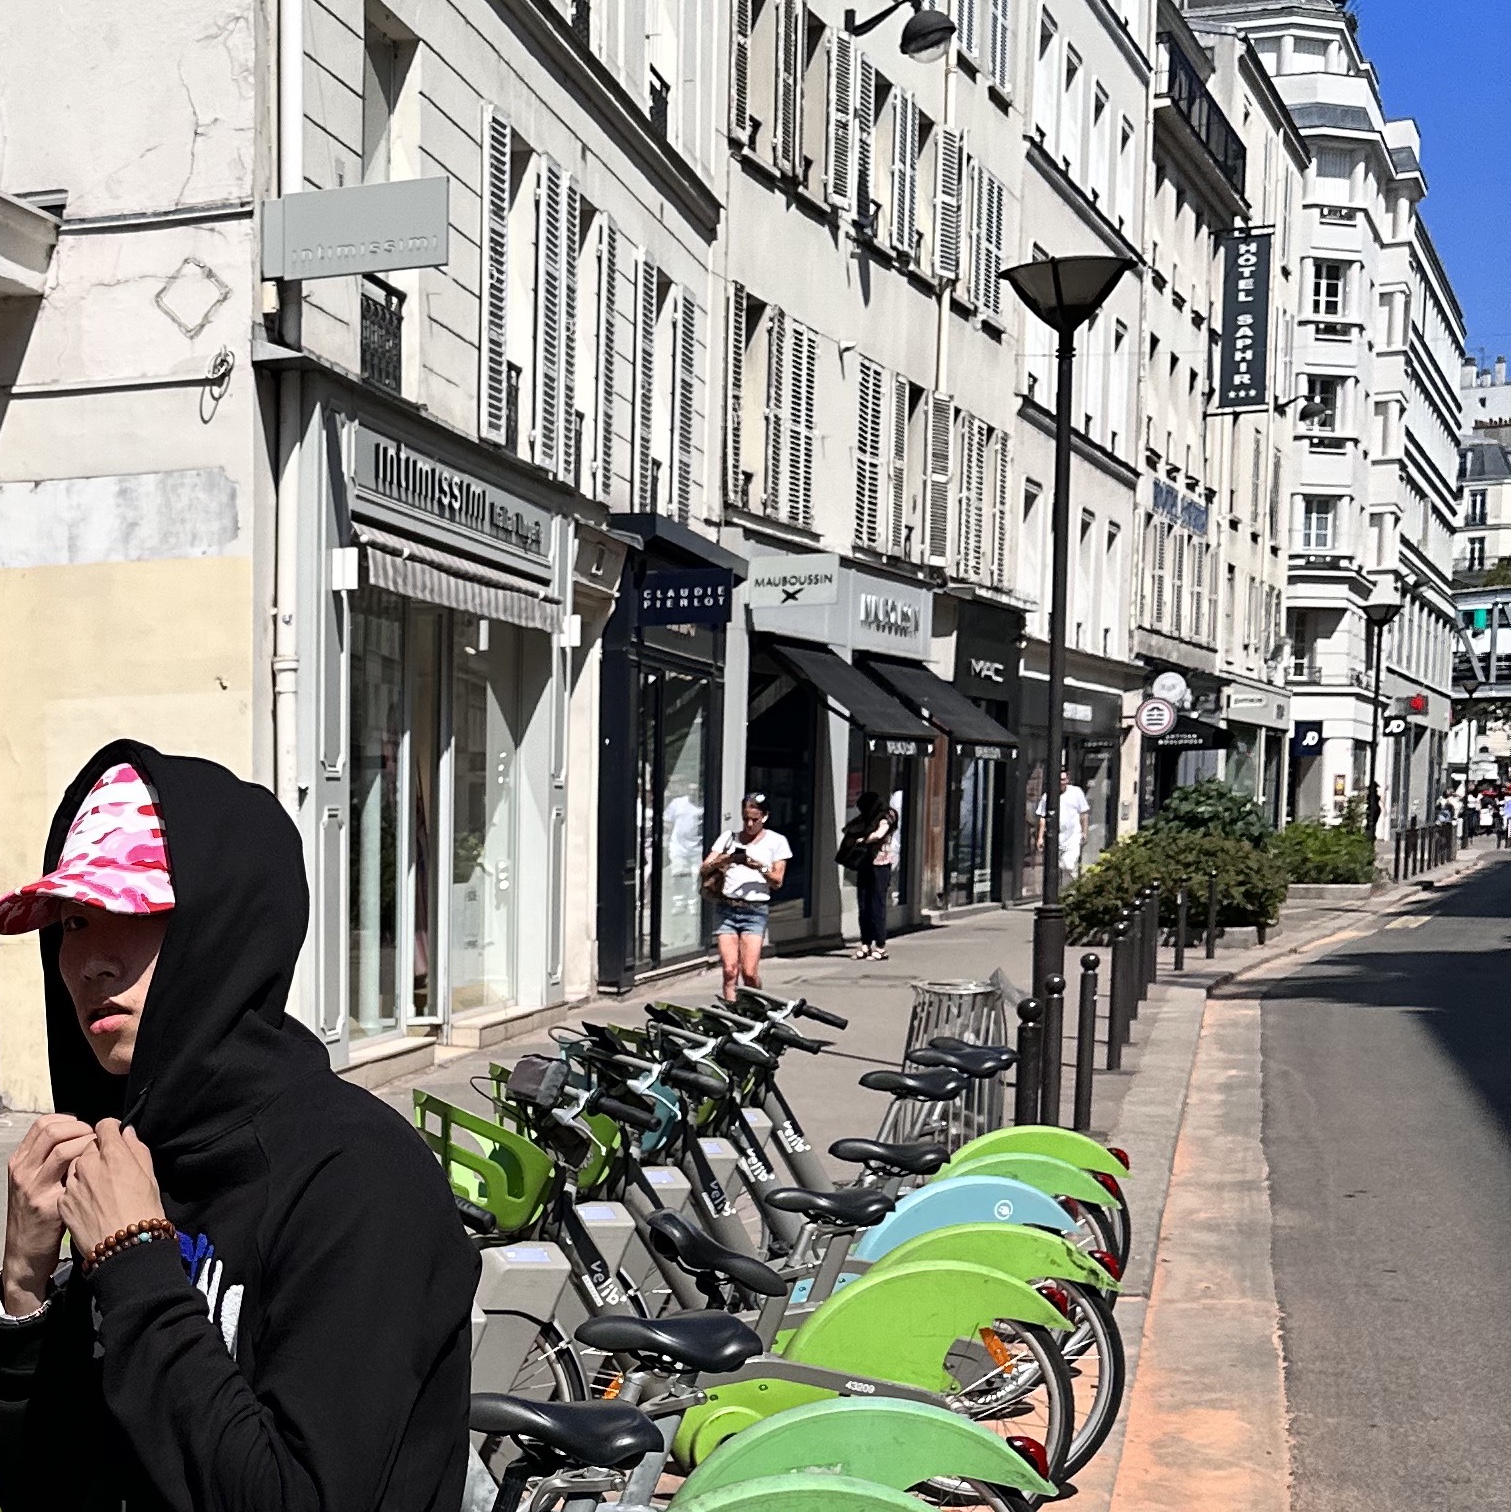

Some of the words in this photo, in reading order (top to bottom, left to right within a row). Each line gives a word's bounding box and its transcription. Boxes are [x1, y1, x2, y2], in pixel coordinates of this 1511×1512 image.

[292, 234, 438, 264] intimissimi
[1232, 313, 1255, 385] SAPHIR
[754, 574, 833, 588] MAUBOUSSIN
[643, 585, 726, 599] CLAUDIE
[643, 596, 725, 610] PIERLOT
